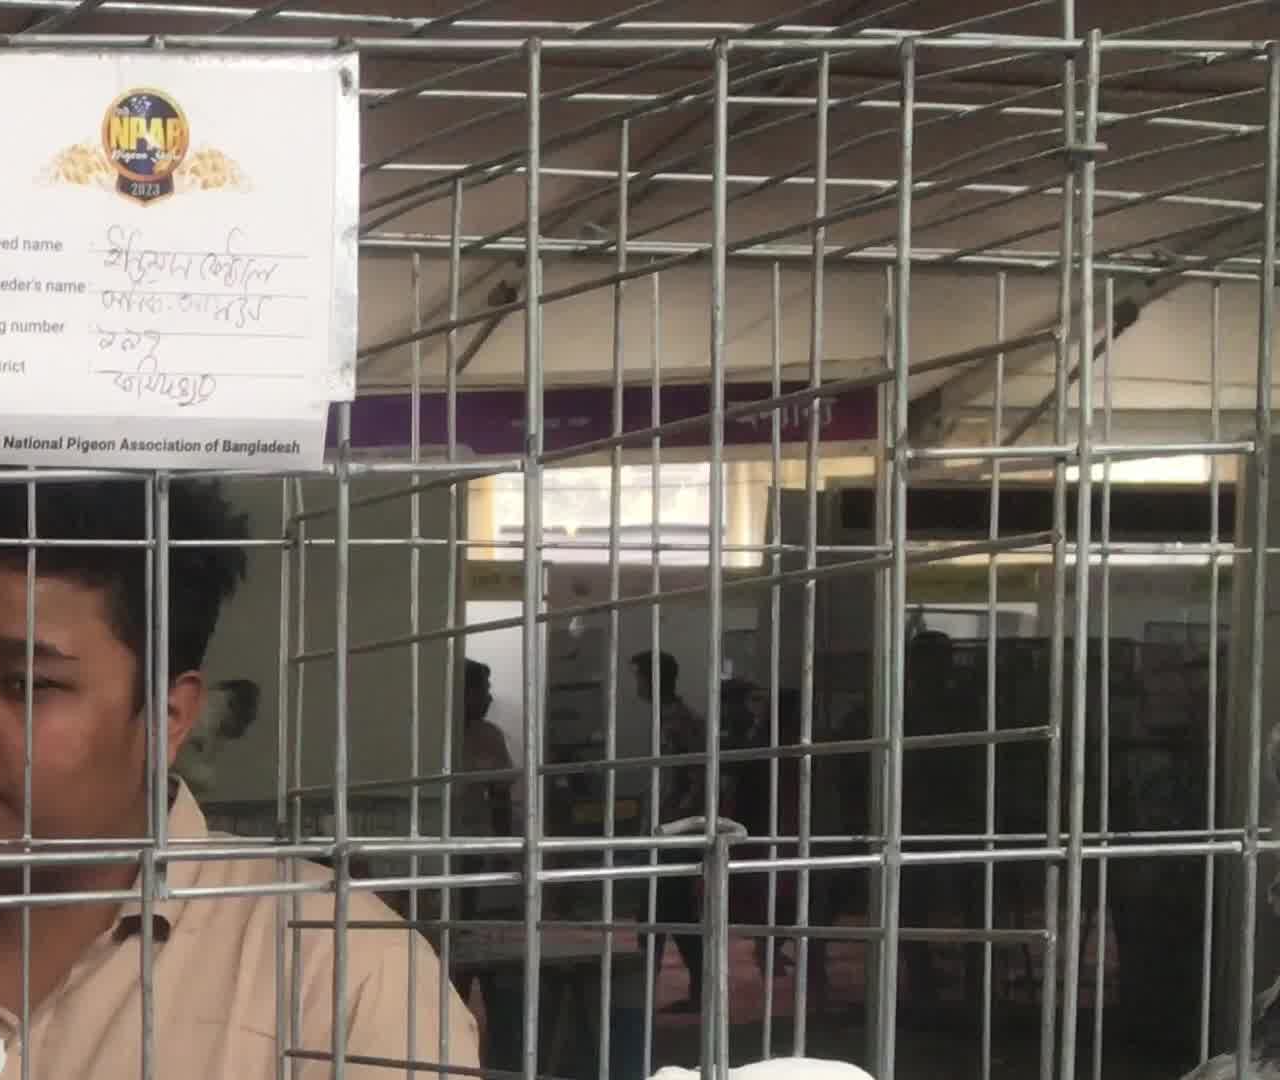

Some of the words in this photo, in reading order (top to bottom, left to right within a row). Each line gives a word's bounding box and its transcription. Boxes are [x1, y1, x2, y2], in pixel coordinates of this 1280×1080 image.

[22, 239, 64, 252] name
[45, 280, 87, 294] name
[9, 319, 65, 334] number
[2, 435, 63, 451] National
[66, 437, 115, 453] Pigeon
[119, 438, 202, 452] Association
[204, 438, 221, 453] of
[221, 440, 300, 456] Bangladesh
